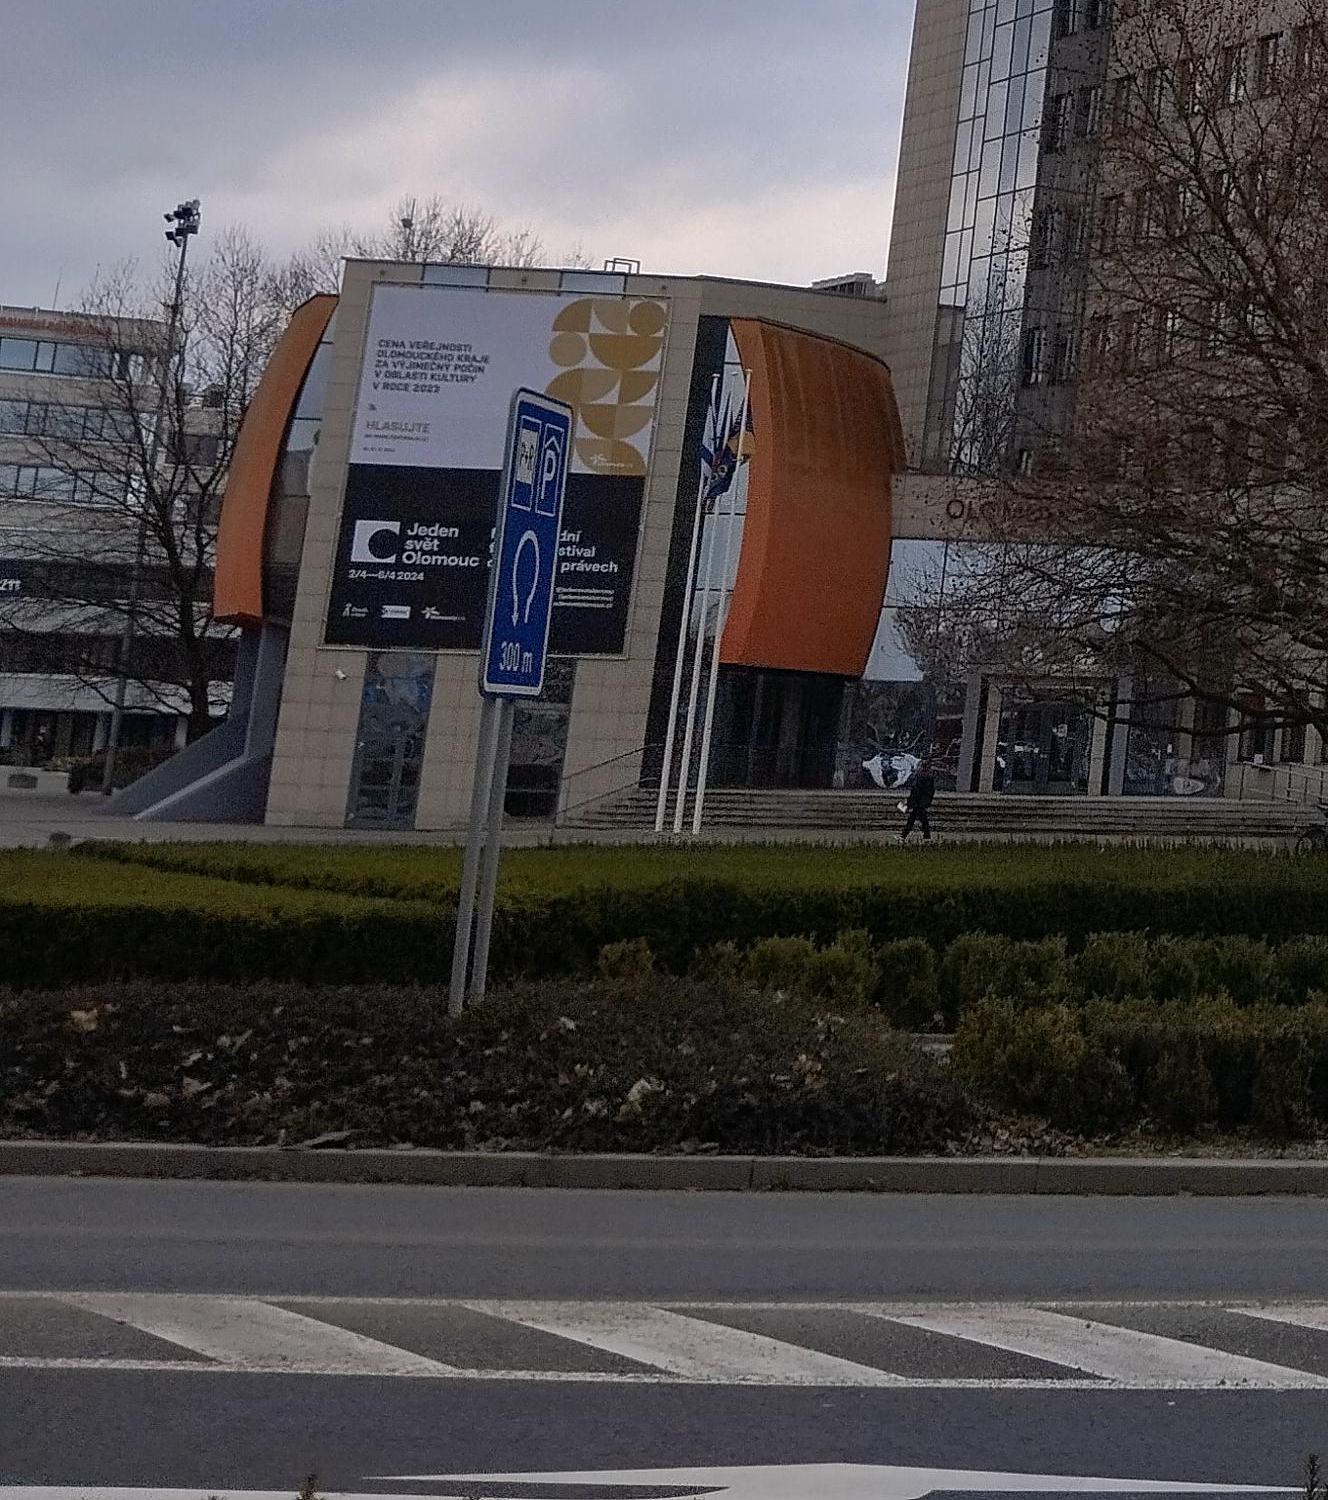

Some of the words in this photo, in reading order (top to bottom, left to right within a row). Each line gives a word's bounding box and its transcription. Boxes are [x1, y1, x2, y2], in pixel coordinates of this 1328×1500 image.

[378, 339, 406, 349] CENA
[457, 354, 490, 364] KRAJE
[374, 370, 382, 378] V
[372, 382, 380, 390] V
[382, 382, 410, 392] ROCE
[407, 522, 459, 538] Jeden
[404, 538, 440, 551] svět
[402, 551, 480, 567] Olomouc
[560, 560, 619, 573] právech
[500, 641, 520, 671] 300
[521, 652, 533, 673] m
